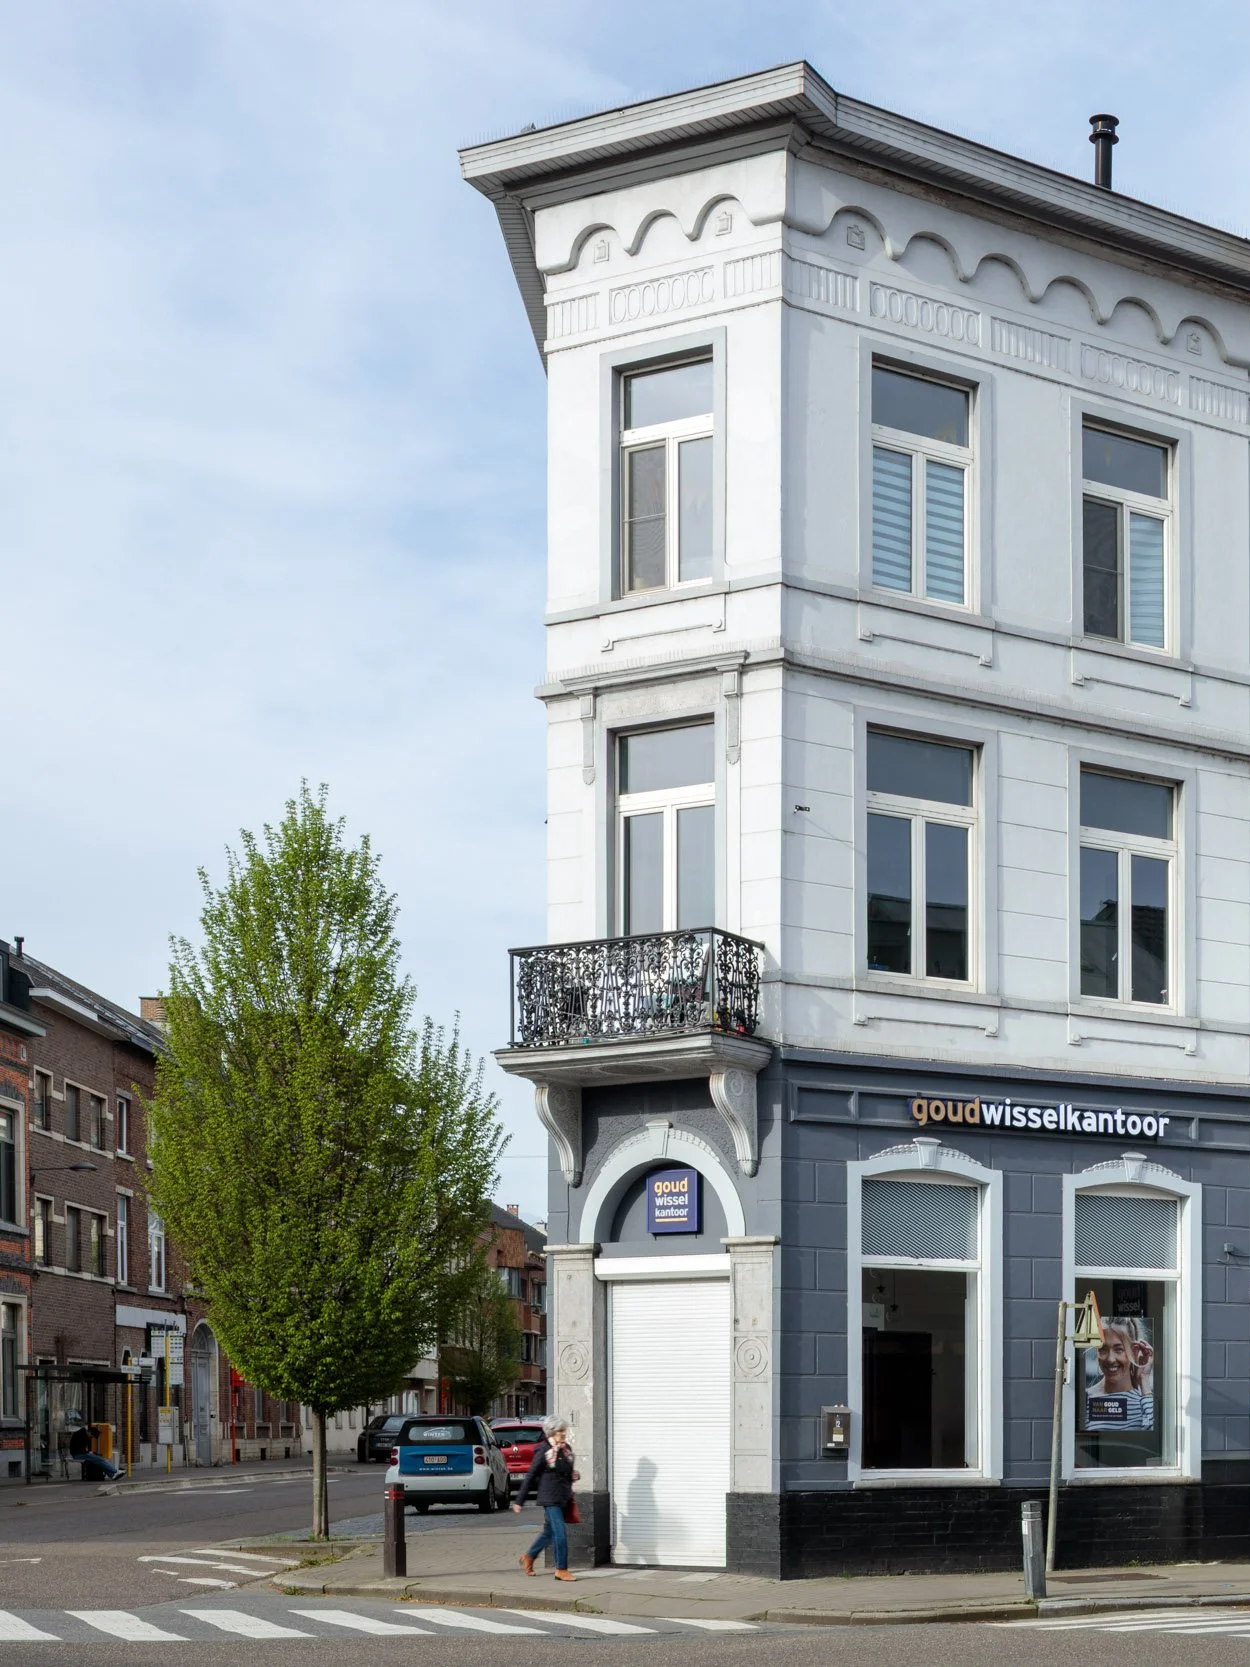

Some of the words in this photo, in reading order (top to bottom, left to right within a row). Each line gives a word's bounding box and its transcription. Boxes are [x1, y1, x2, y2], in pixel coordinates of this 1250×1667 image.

[911, 1096, 1170, 1137] goudwisselkantoor
[654, 1177, 688, 1196] goud
[655, 1194, 688, 1206] wissel
[655, 1207, 688, 1217] kantoor
[1117, 1300, 1140, 1312] wissel
